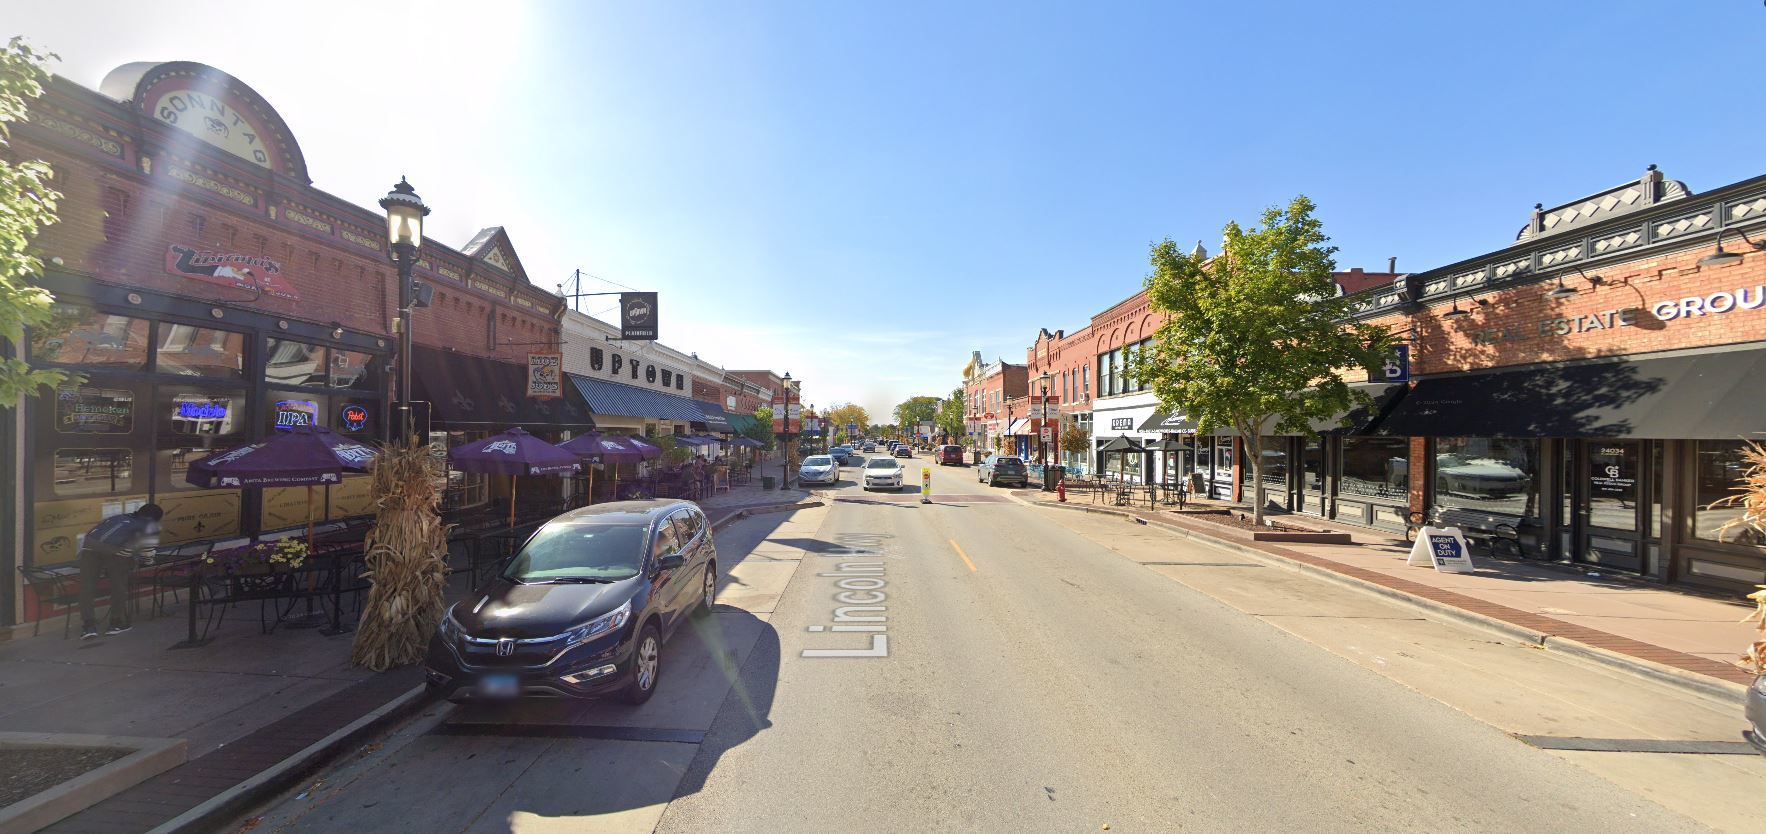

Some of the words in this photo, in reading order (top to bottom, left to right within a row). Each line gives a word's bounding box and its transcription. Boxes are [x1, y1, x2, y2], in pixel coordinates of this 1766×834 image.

[160, 93, 267, 163] SONNTAG
[1472, 325, 1528, 346] REAL
[1538, 308, 1638, 338] ESTATE
[590, 346, 684, 390] UPTOWN
[277, 411, 310, 426] IPA
[347, 410, 365, 421] Pabst
